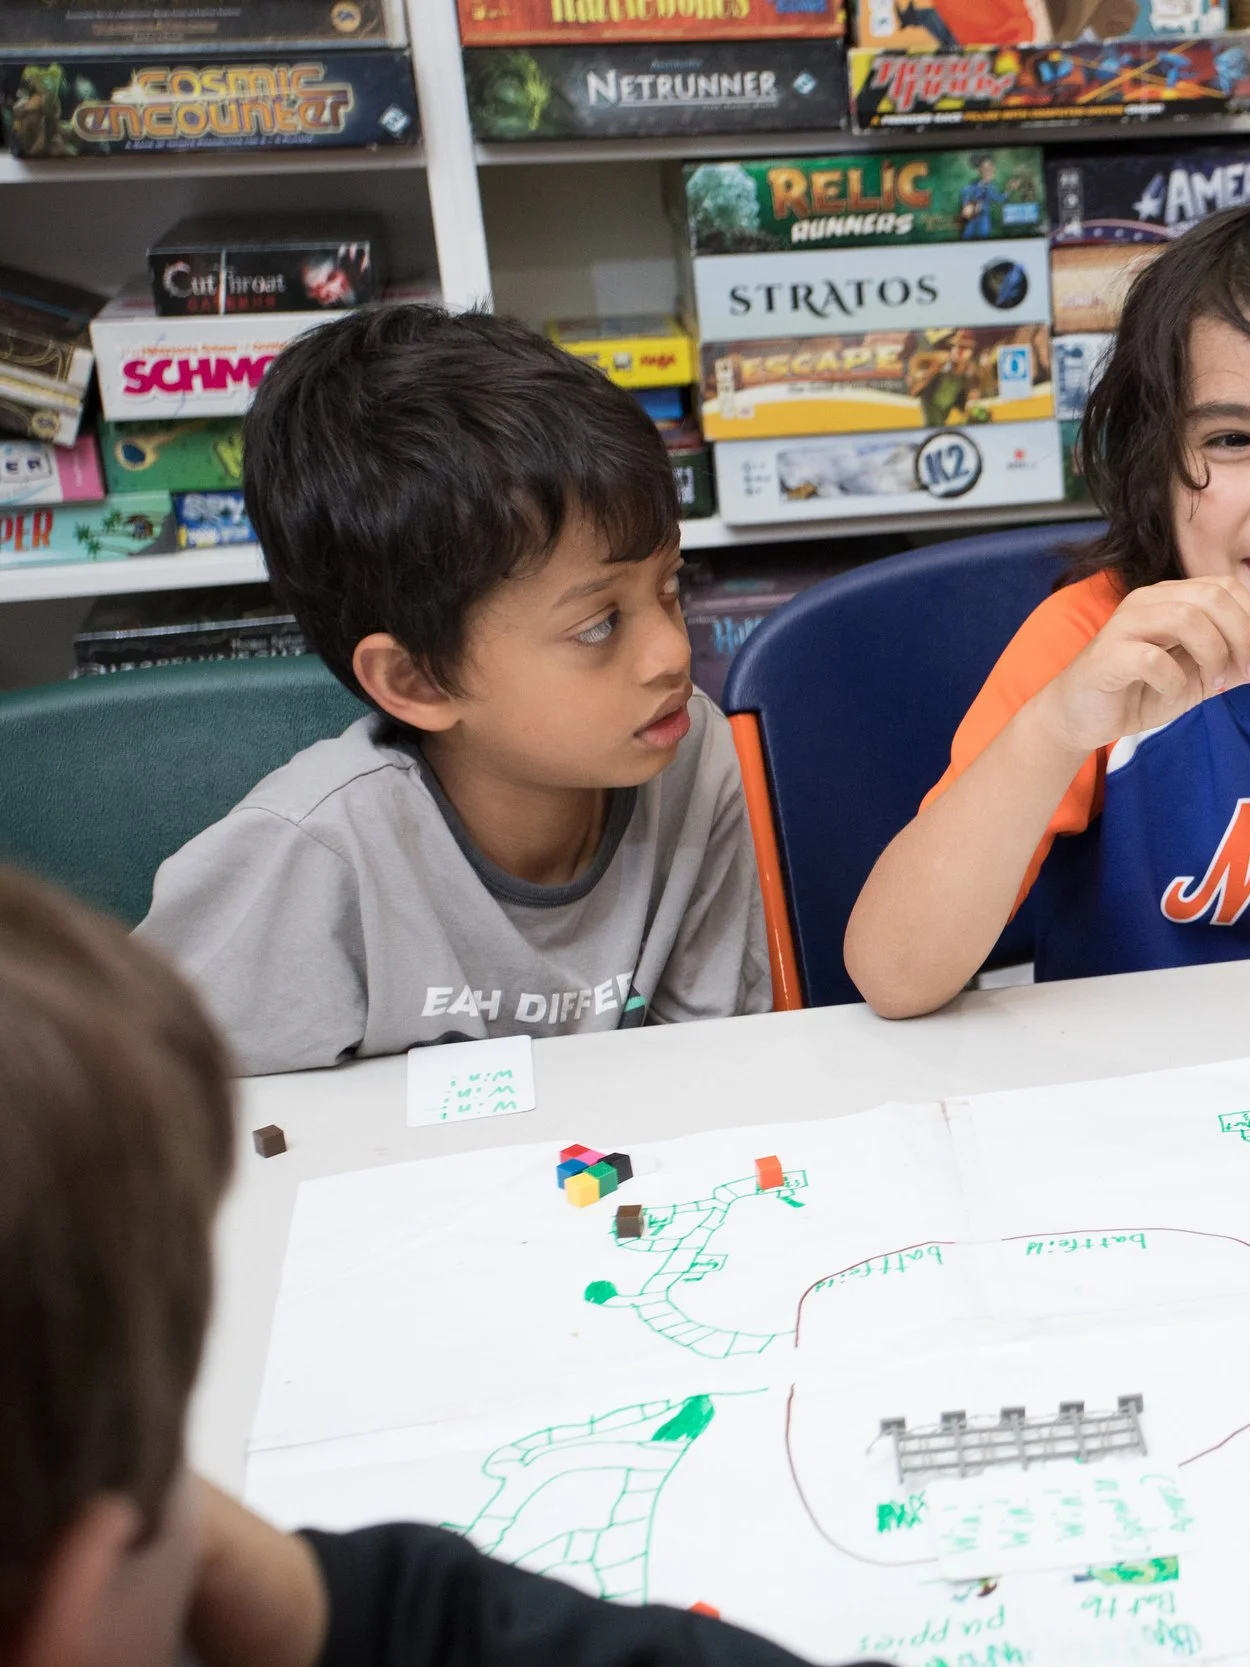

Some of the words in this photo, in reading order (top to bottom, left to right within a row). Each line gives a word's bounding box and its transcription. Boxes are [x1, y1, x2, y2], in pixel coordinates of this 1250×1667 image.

[587, 69, 777, 107] NETRUNNER
[768, 160, 932, 221] RELIC
[791, 211, 914, 244] RUNNERS
[728, 274, 940, 320] STRATOS
[740, 344, 905, 385] ESCAPE
[924, 444, 970, 485] K2
[421, 984, 502, 1021] EAH
